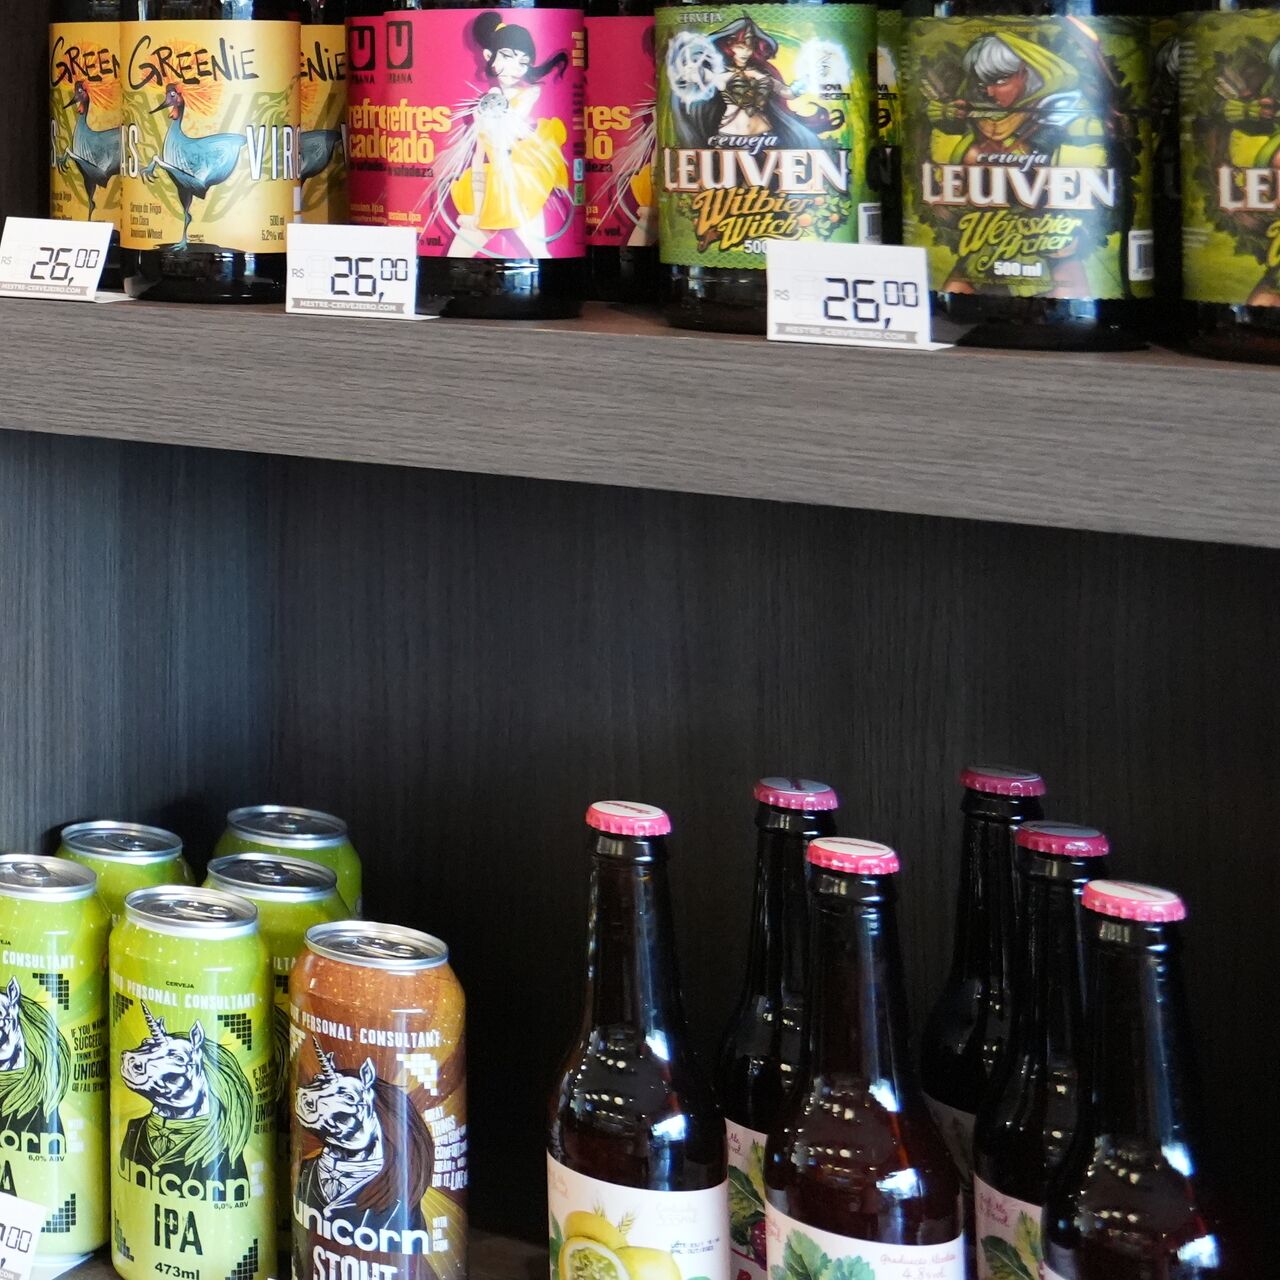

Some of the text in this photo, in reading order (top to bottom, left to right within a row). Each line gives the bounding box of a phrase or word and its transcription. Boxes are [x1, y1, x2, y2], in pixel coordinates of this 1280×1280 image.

[676, 11, 725, 24] CERVEJA
[127, 34, 260, 91] GREENIE
[386, 97, 453, 134] refres
[386, 132, 436, 164] cadô
[707, 132, 779, 156] cerveja
[976, 149, 1049, 171] cerveja
[662, 146, 853, 194] LEUVEN
[921, 162, 1116, 210] LEUVEN
[269, 215, 279, 226] 500
[692, 187, 818, 237] Witbier
[716, 214, 803, 252] Witch
[744, 240, 768, 255] 500
[957, 209, 1083, 257] Weissbier
[29, 246, 101, 288] 26,00
[978, 233, 1074, 271] Archer
[993, 260, 1042, 277] 500 ml
[330, 256, 409, 303] 26,00
[298, 297, 399, 313] MESTRE-CERVEJEIRO.COM
[823, 276, 920, 329] 26,00
[2, 950, 76, 969] CONSULTANT
[127, 979, 256, 1010] PERSONAL CONSULTANT
[165, 980, 195, 990] CERVEJA
[77, 1025, 91, 1037] YOU
[302, 1011, 441, 1048] PERSONAL CONSULTANT
[48, 1155, 66, 1163] ABV
[118, 1157, 251, 1203] unicorn
[214, 1201, 249, 1211] 6,0% ABV
[153, 1203, 204, 1256] IPA
[293, 1193, 430, 1255] unicorn
[154, 1261, 201, 1280] 473ml
[312, 1245, 398, 1280] STOUT
